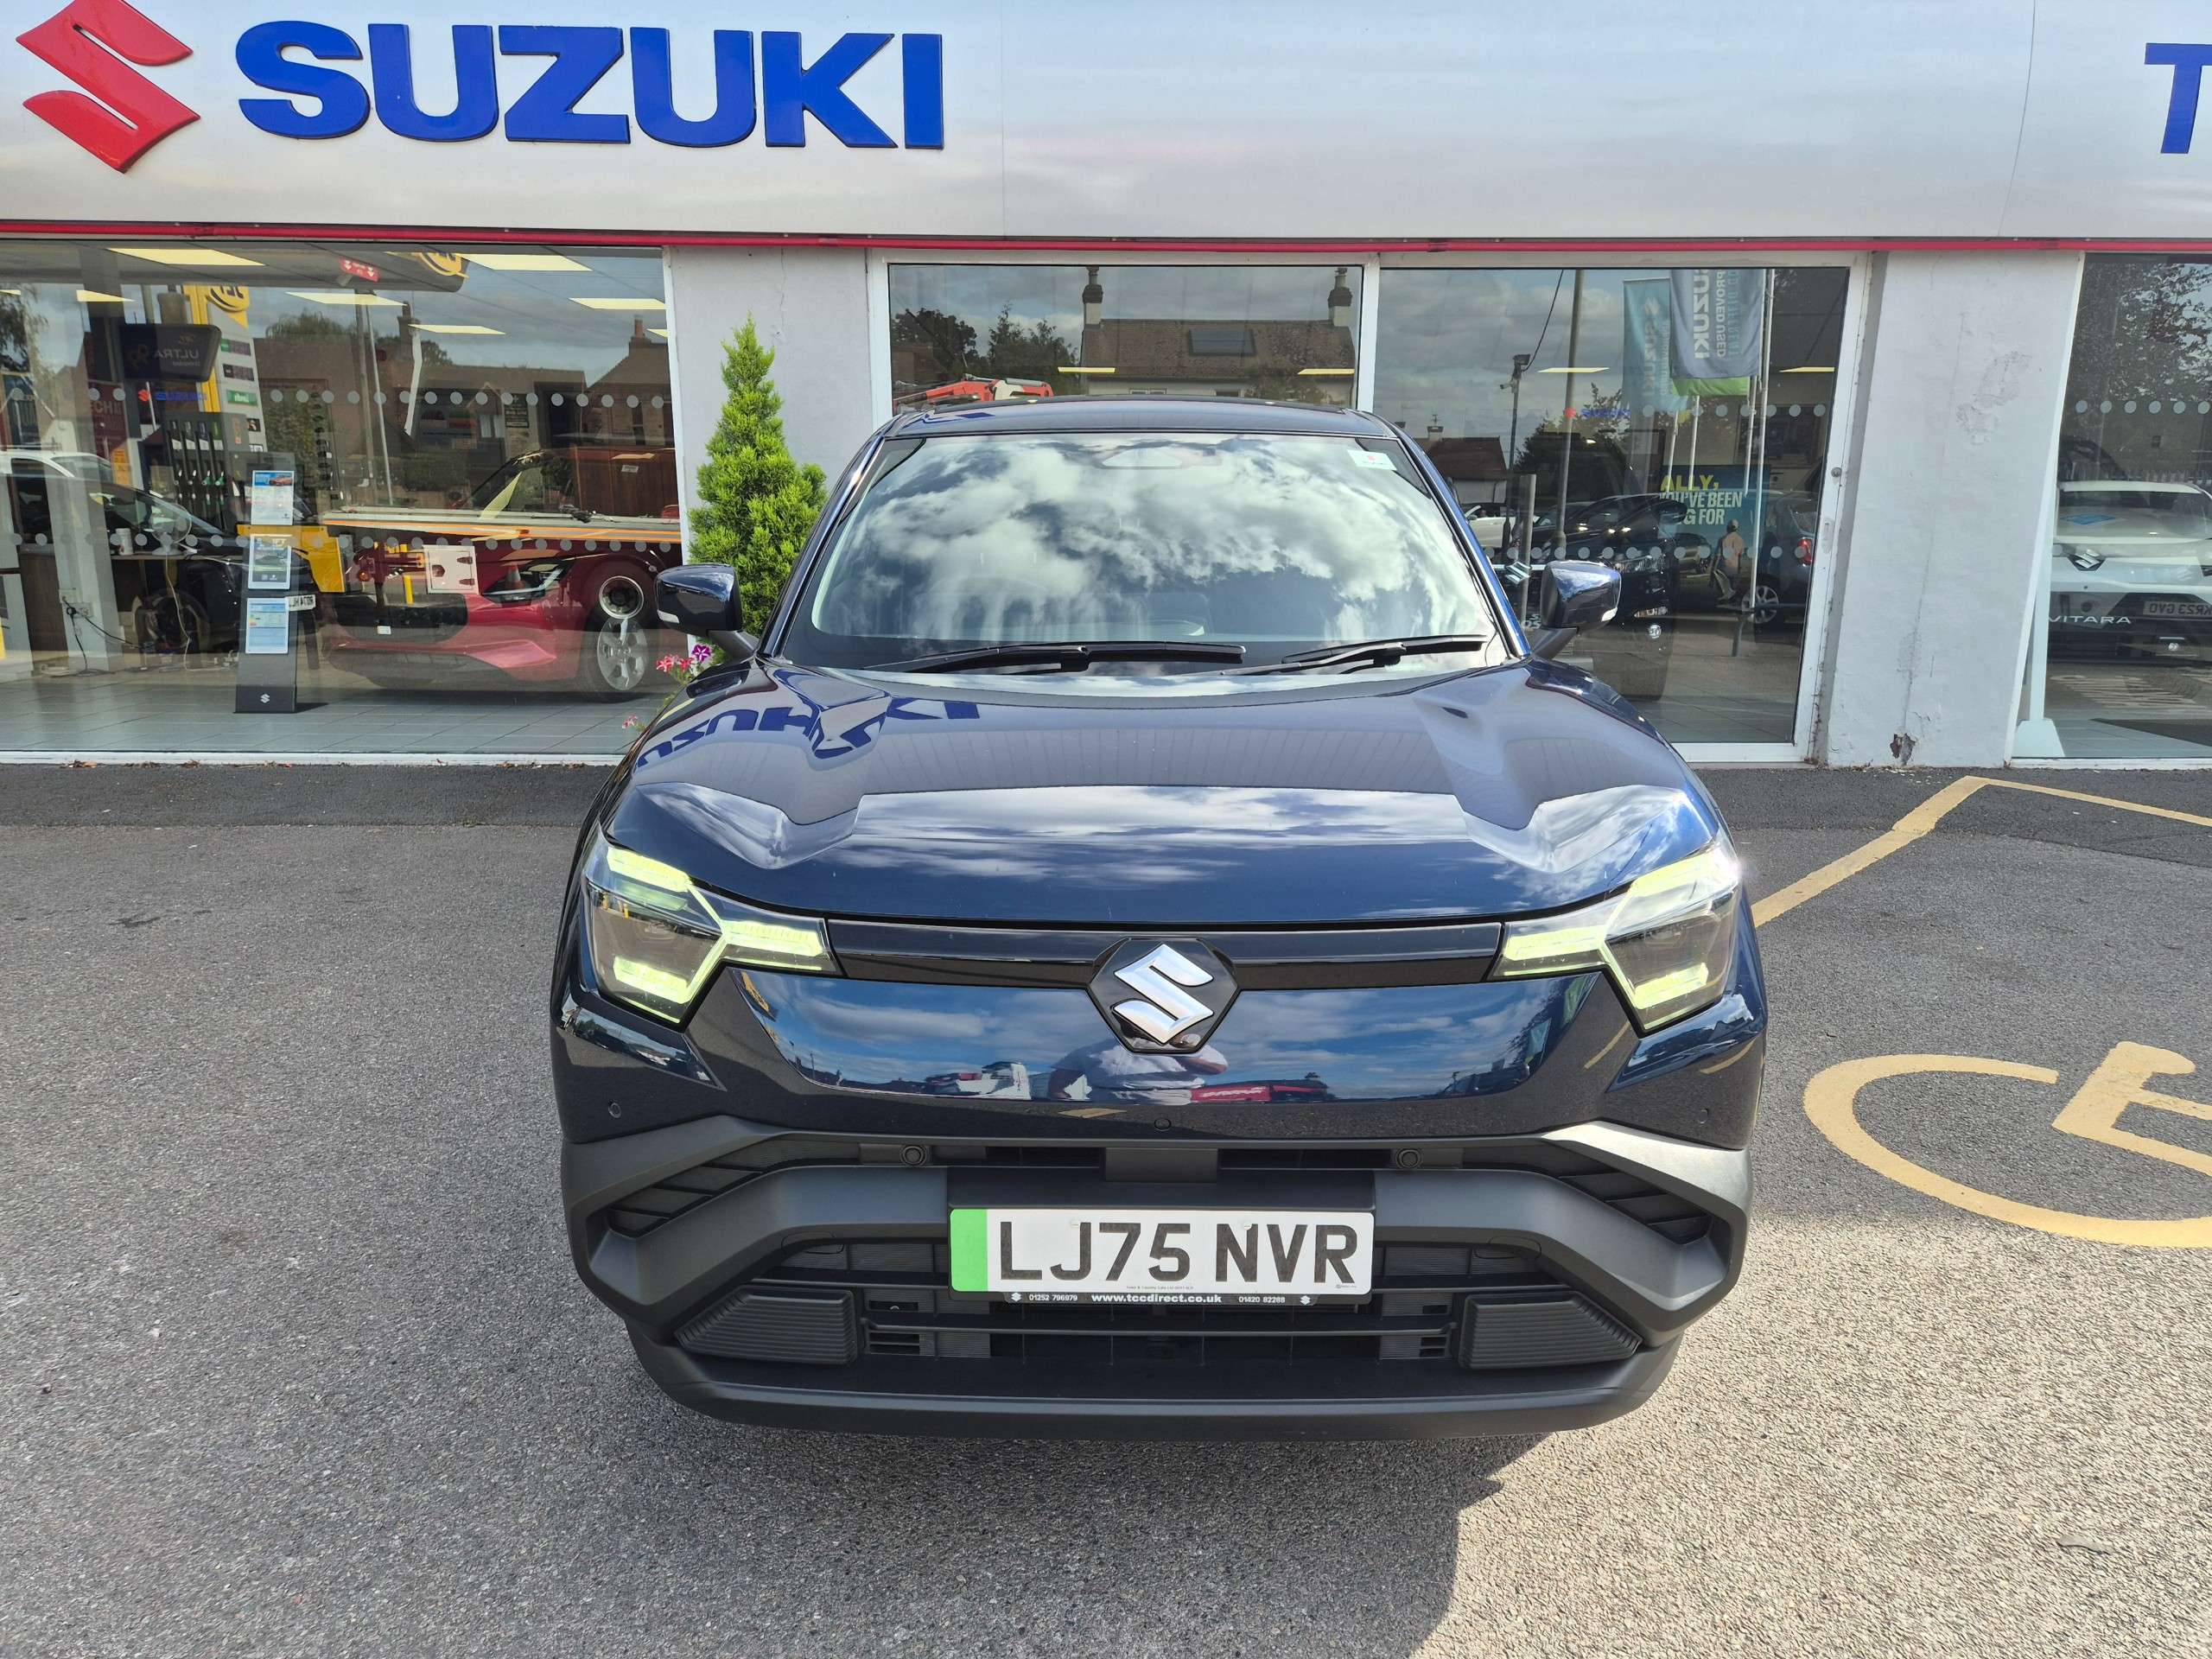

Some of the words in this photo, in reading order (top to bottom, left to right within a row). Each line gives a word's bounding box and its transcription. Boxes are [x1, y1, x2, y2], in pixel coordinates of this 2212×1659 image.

[235, 20, 944, 149] SUZUKI
[1707, 492, 1743, 508] BEEN
[1698, 508, 1726, 524] FOR
[2049, 615, 2132, 624] VITARA
[1000, 1221, 1192, 1282] LJ75
[1215, 1223, 1358, 1284] NVR
[1091, 1293, 1222, 1305] www.tccdirect.co.uk
